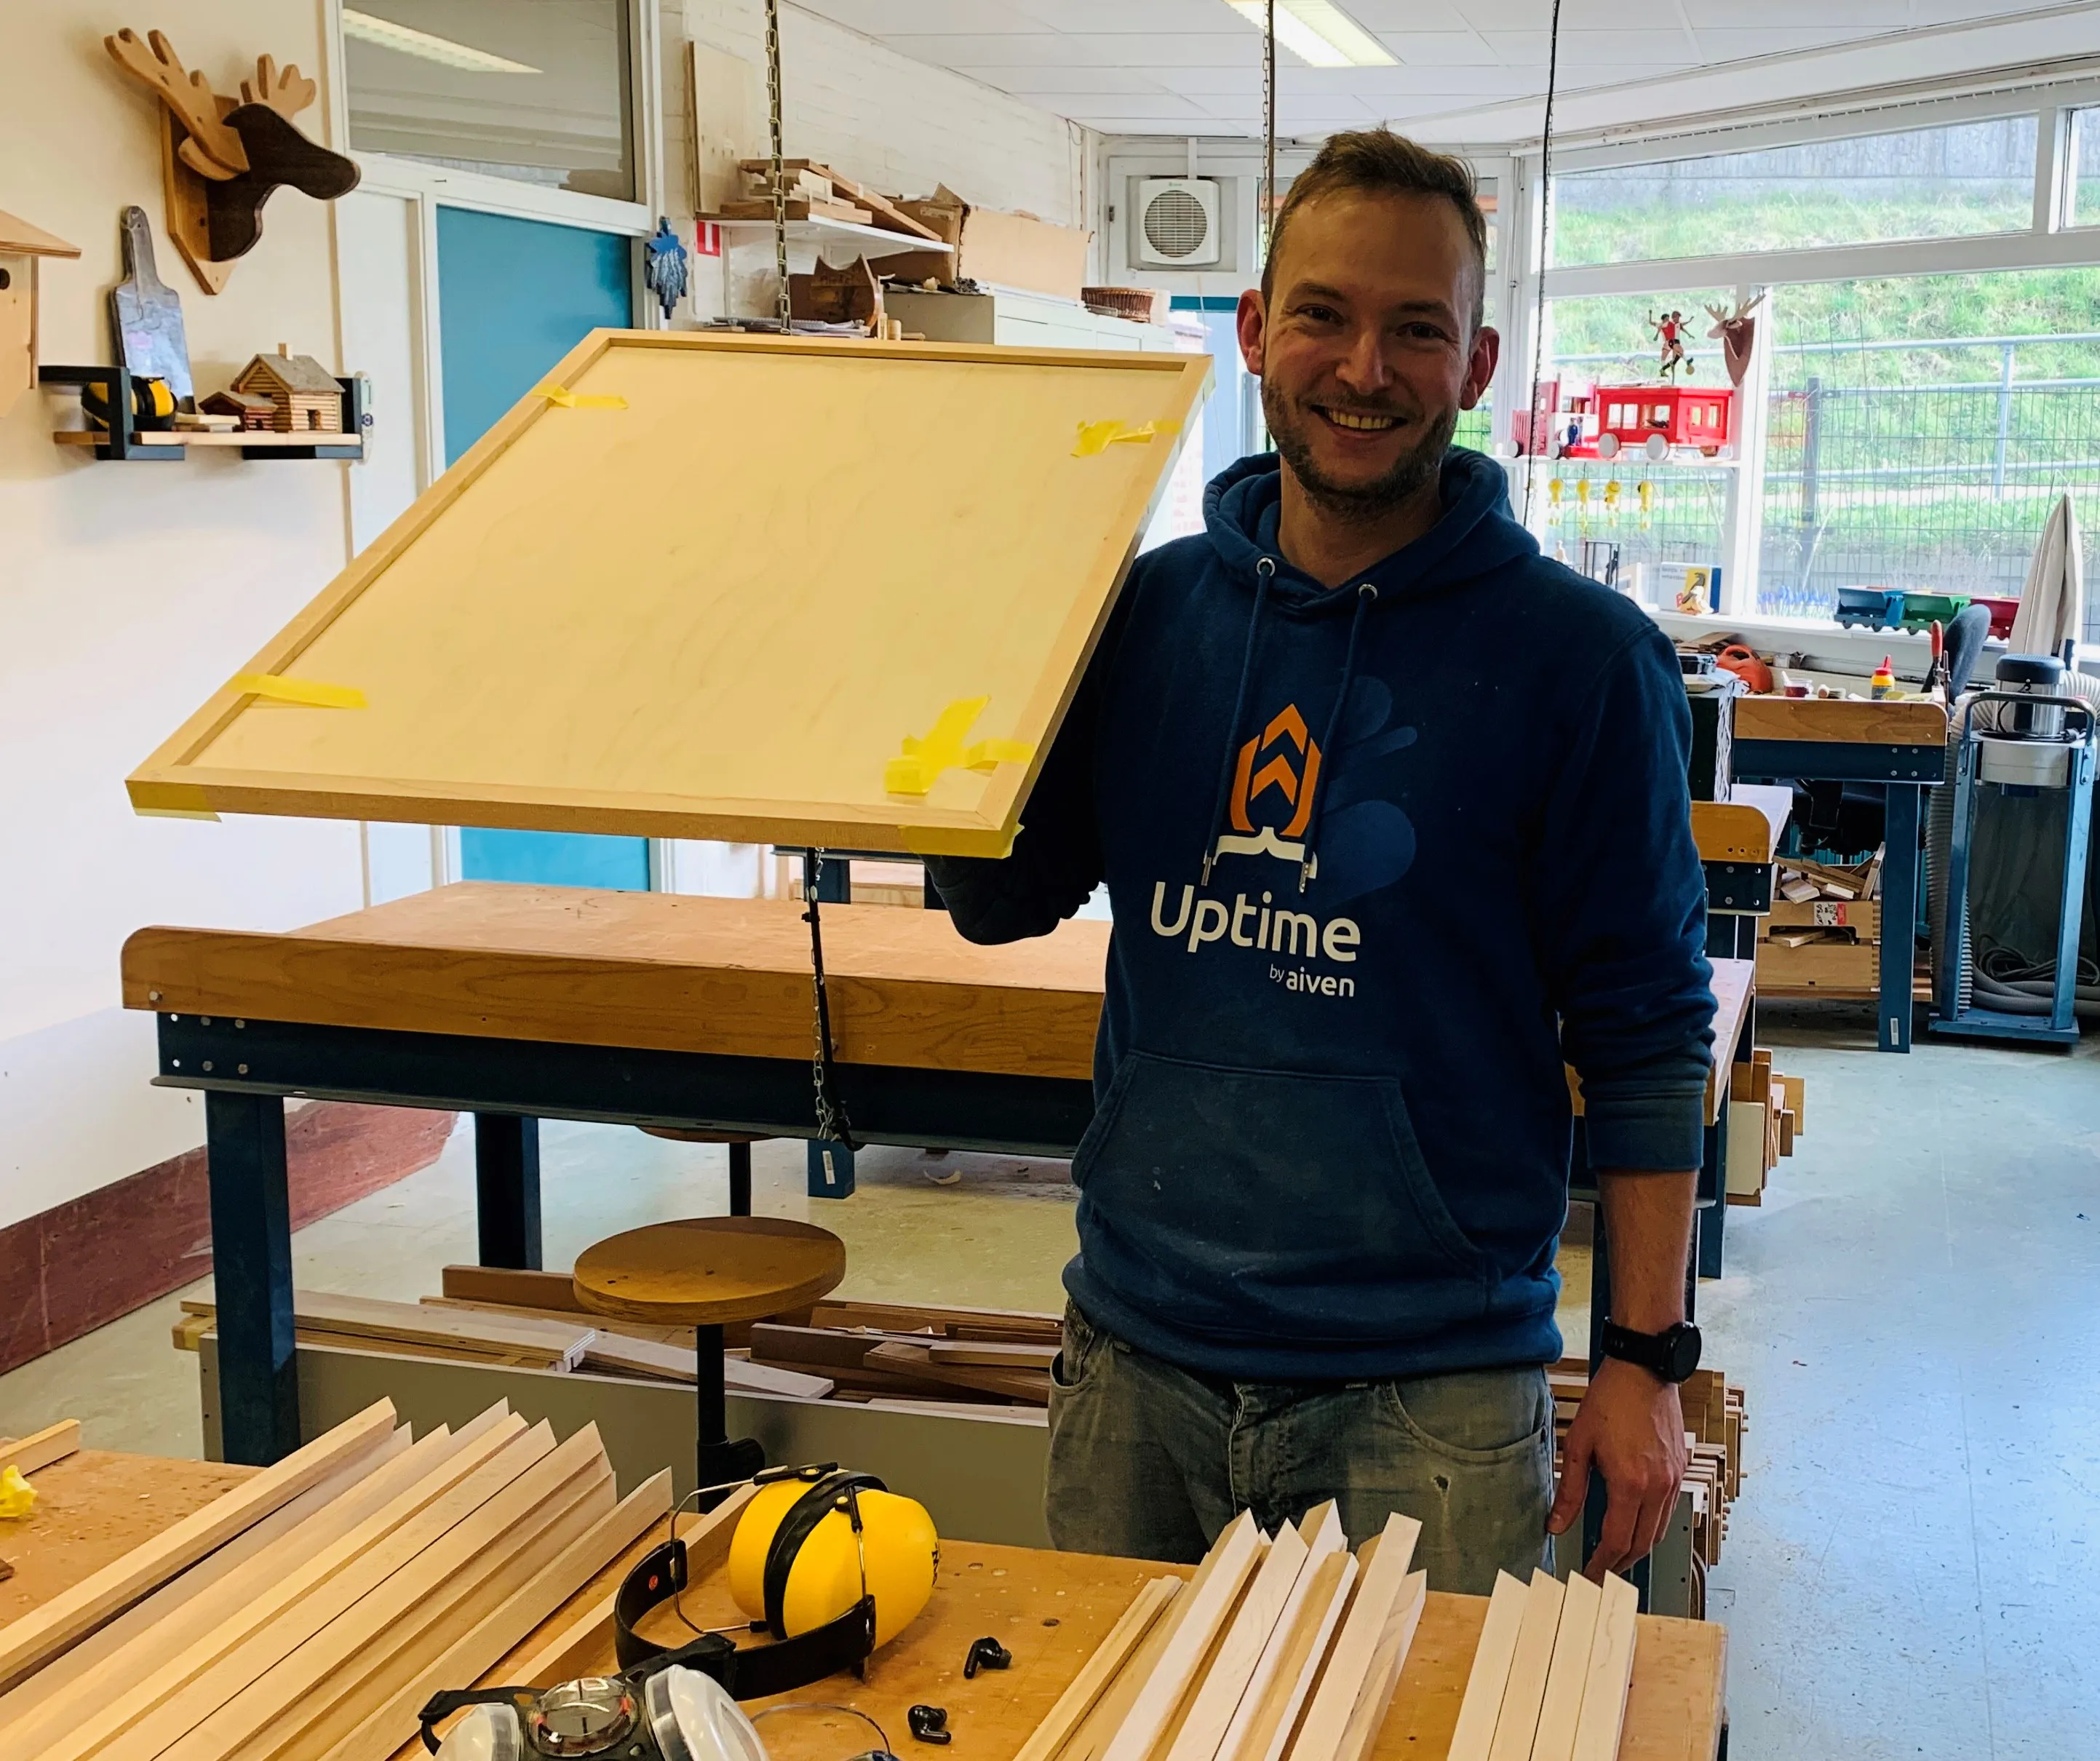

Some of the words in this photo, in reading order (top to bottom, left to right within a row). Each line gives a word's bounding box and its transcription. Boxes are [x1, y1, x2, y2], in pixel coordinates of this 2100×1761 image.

[1150, 880, 1361, 962] Uptime
[1269, 963, 1284, 982] by
[1286, 966, 1354, 998] aiven
